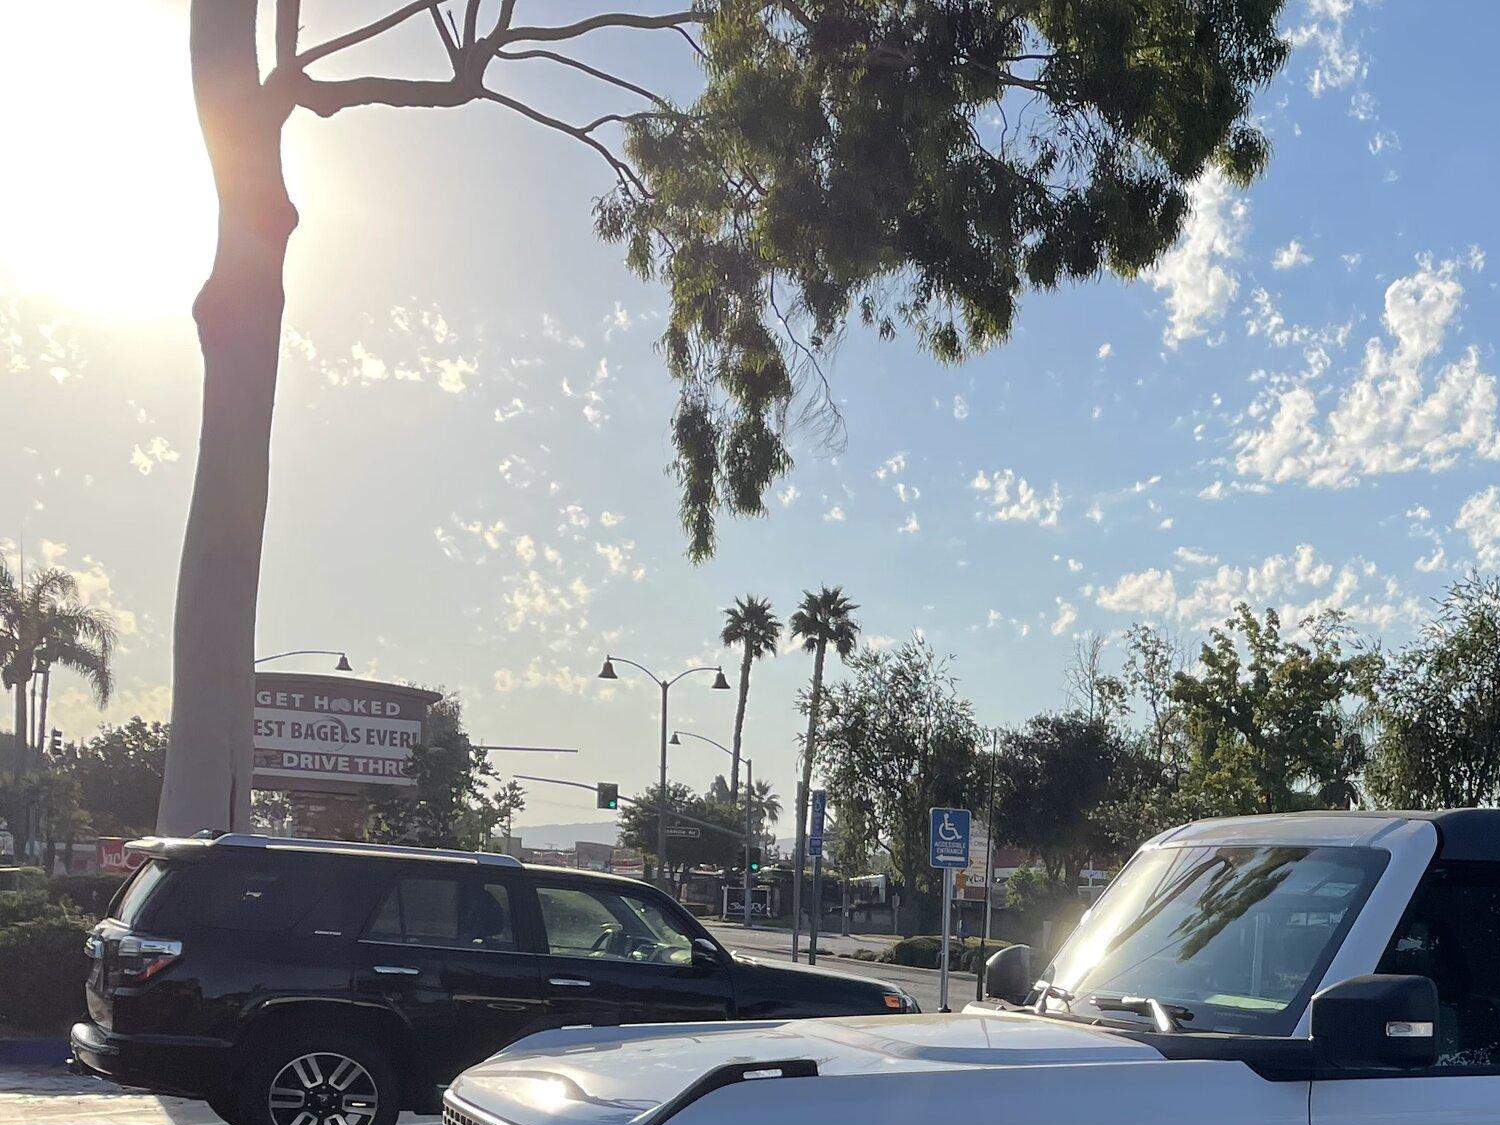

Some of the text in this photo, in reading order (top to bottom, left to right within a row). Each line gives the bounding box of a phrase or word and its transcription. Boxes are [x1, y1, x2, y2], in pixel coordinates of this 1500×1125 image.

[256, 690, 304, 708] GET
[253, 719, 286, 738] EST
[290, 721, 361, 744] BAGELS
[282, 753, 350, 772] DRIVE
[934, 841, 966, 849] ACCESSIBLE
[936, 847, 964, 855] ENTRANCE
